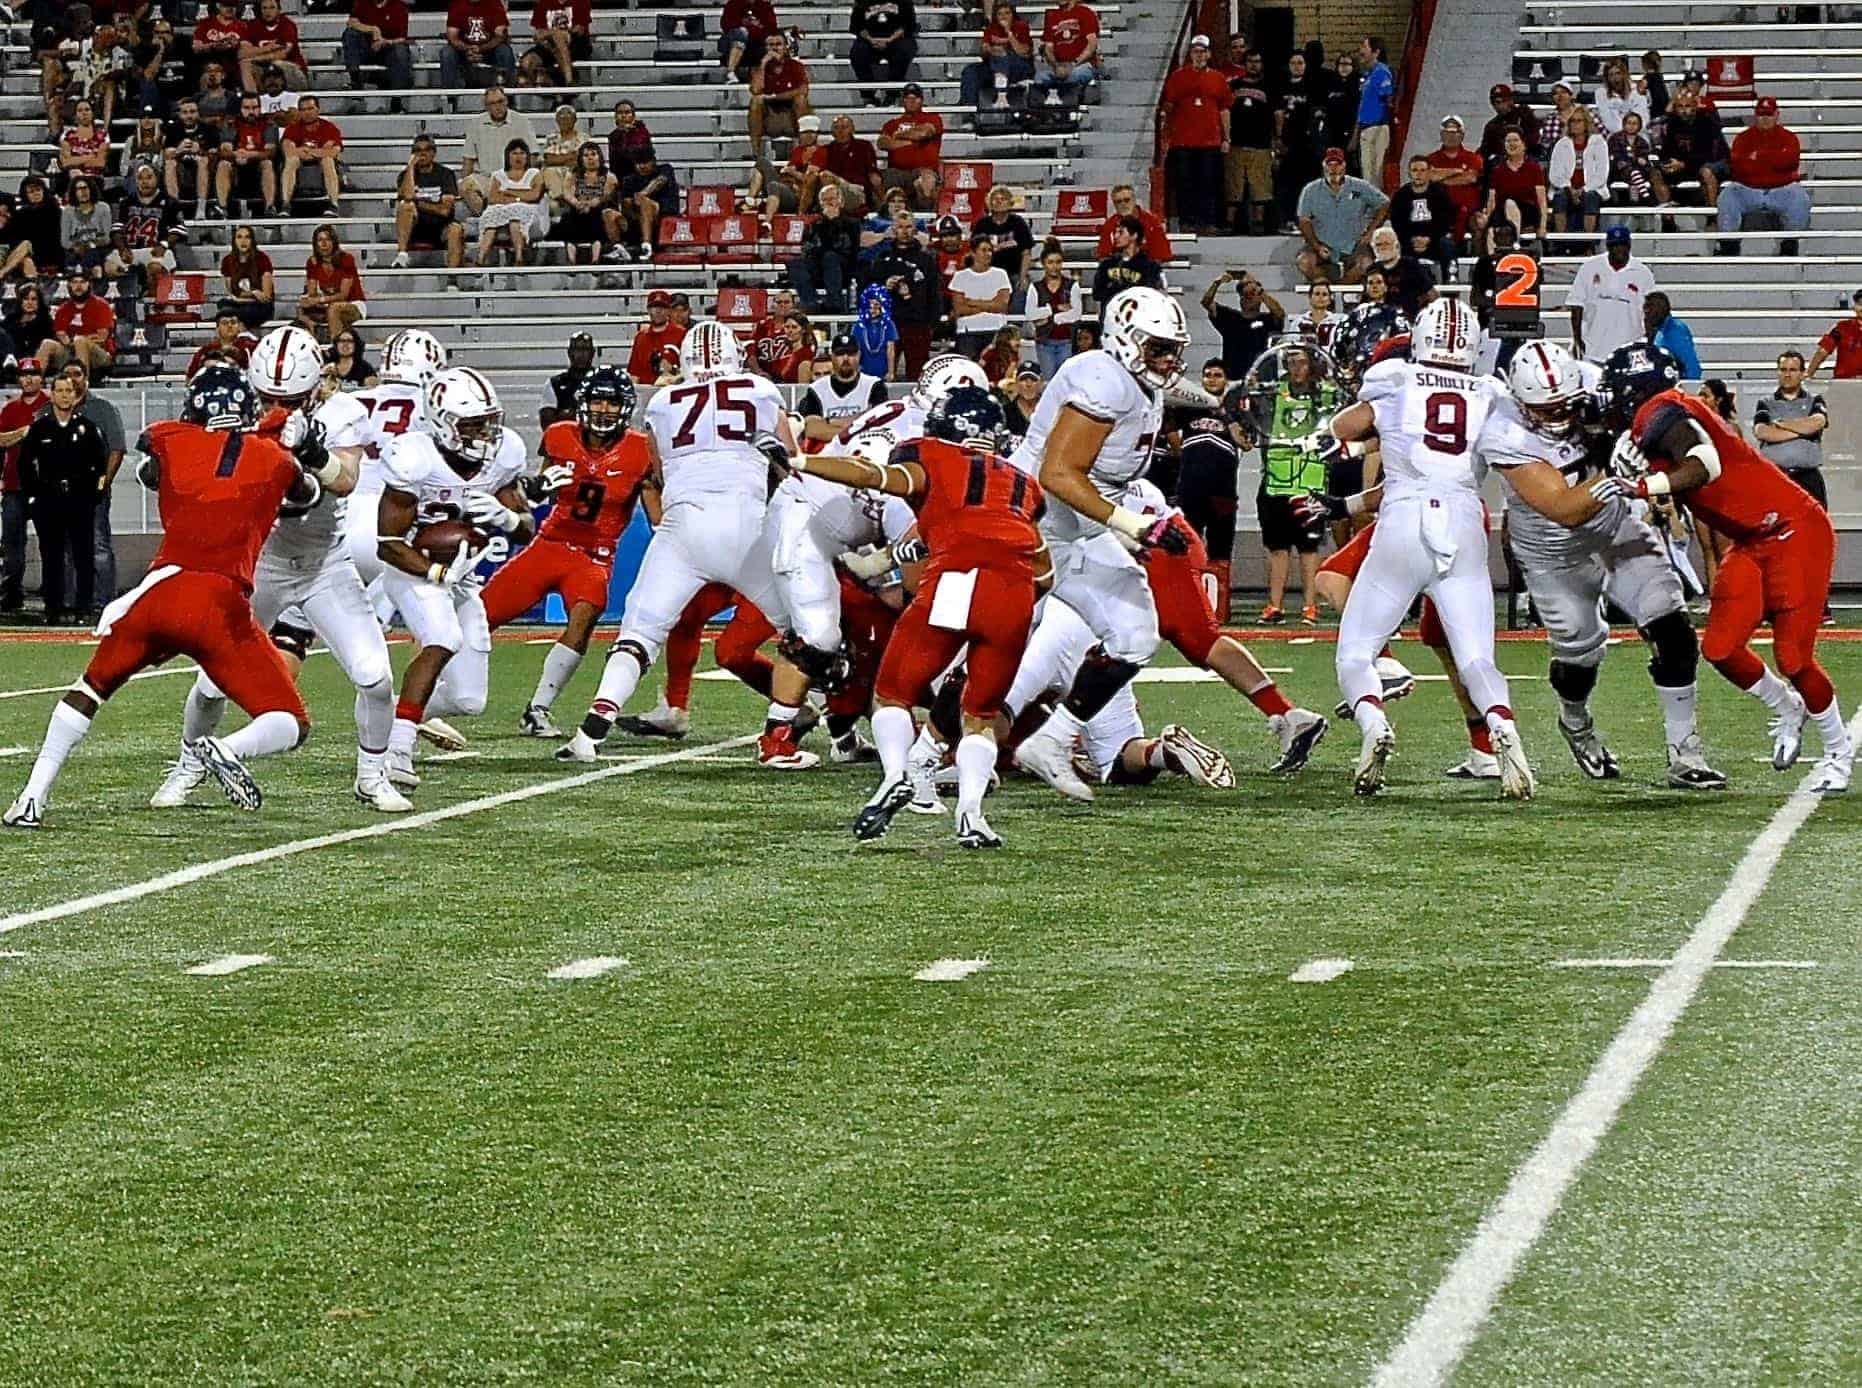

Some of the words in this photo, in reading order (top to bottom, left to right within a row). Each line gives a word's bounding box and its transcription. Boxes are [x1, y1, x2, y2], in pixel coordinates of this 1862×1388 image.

[466, 18, 488, 41] A
[1411, 199, 1432, 221] A
[168, 279, 190, 300] A
[1494, 254, 1539, 306] 2
[1628, 349, 1655, 374] A
[670, 379, 757, 449] 75
[1423, 391, 1468, 457] 9
[570, 480, 608, 524] 9
